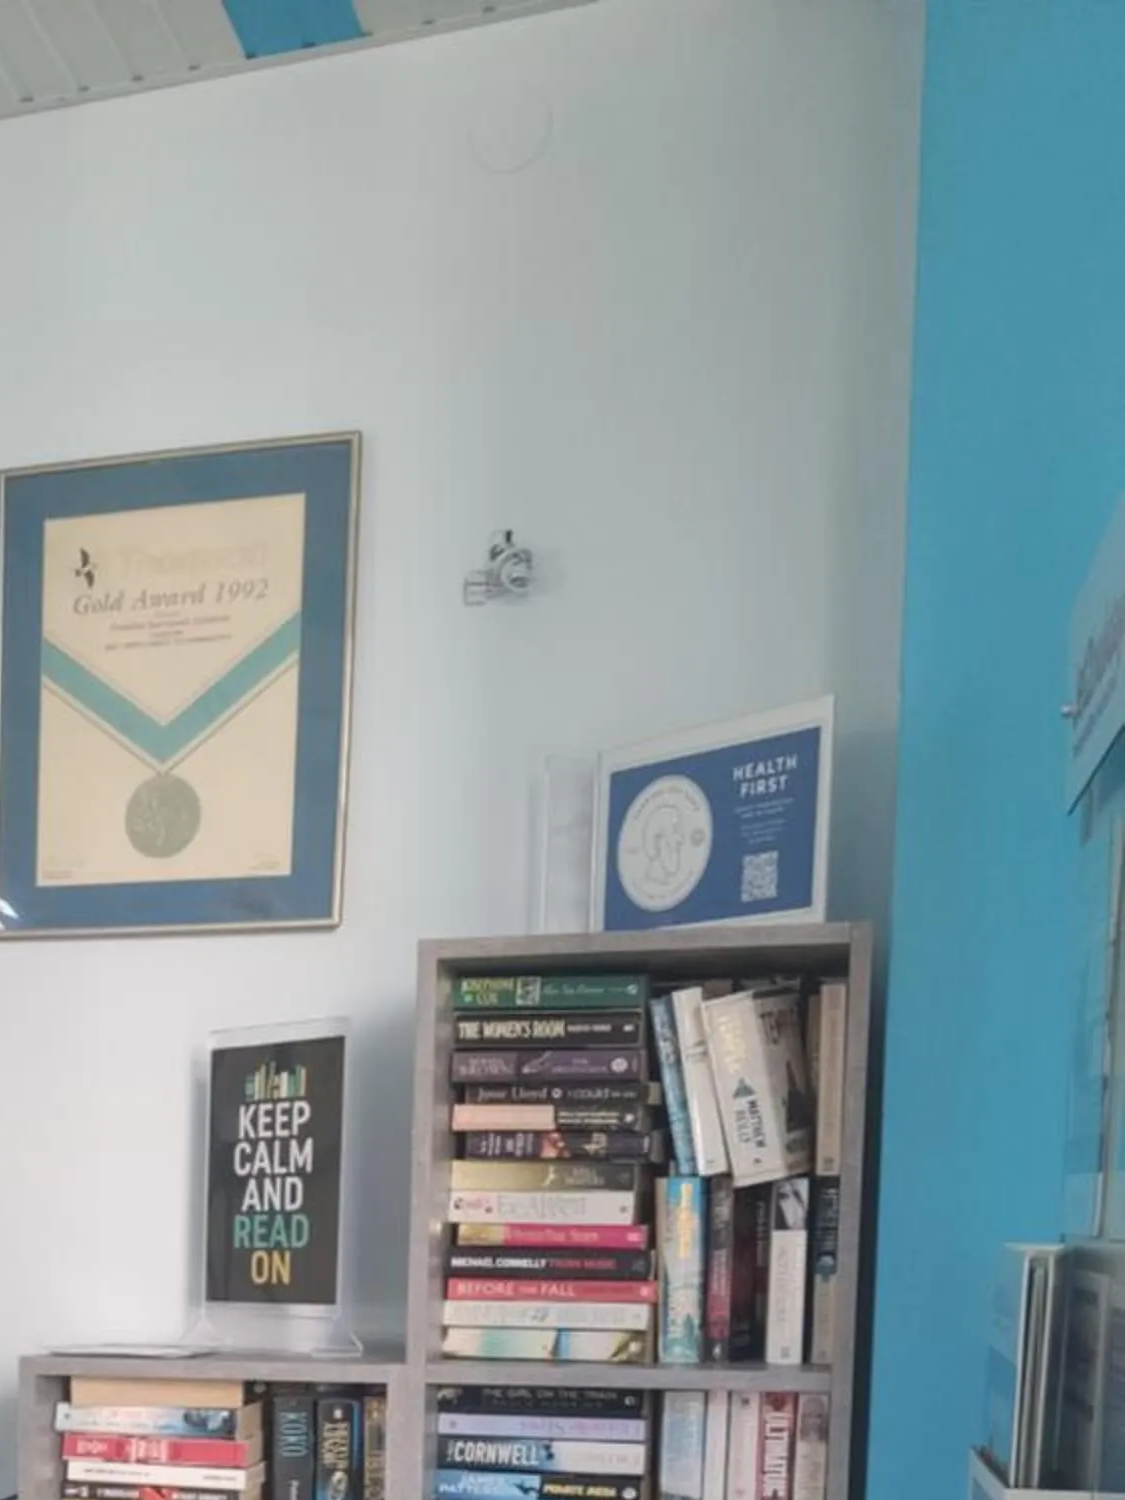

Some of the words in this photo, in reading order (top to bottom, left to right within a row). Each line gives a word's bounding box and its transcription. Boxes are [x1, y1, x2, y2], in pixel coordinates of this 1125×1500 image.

[73, 591, 124, 615] Gold
[131, 582, 206, 611] Award
[215, 578, 269, 603] 1992
[733, 754, 797, 781] HEALTH
[740, 775, 789, 797] FIRST
[459, 1021, 480, 1039] THE
[483, 1020, 531, 1038] WOMEN'S
[532, 1020, 566, 1038] ROOM
[238, 1100, 311, 1139] KEEP
[748, 1100, 767, 1149] MATTHEW
[233, 1139, 313, 1176] CALM
[241, 1176, 304, 1212] AND
[233, 1214, 310, 1248] READ
[250, 1251, 291, 1285] ON
[451, 1256, 495, 1268] MICHAEL
[496, 1257, 547, 1269] CONNELLY
[457, 1282, 514, 1296] BEFORE
[540, 1283, 575, 1297] FALL
[279, 1411, 307, 1456] KOKO
[454, 1441, 541, 1466] CORNWELL
